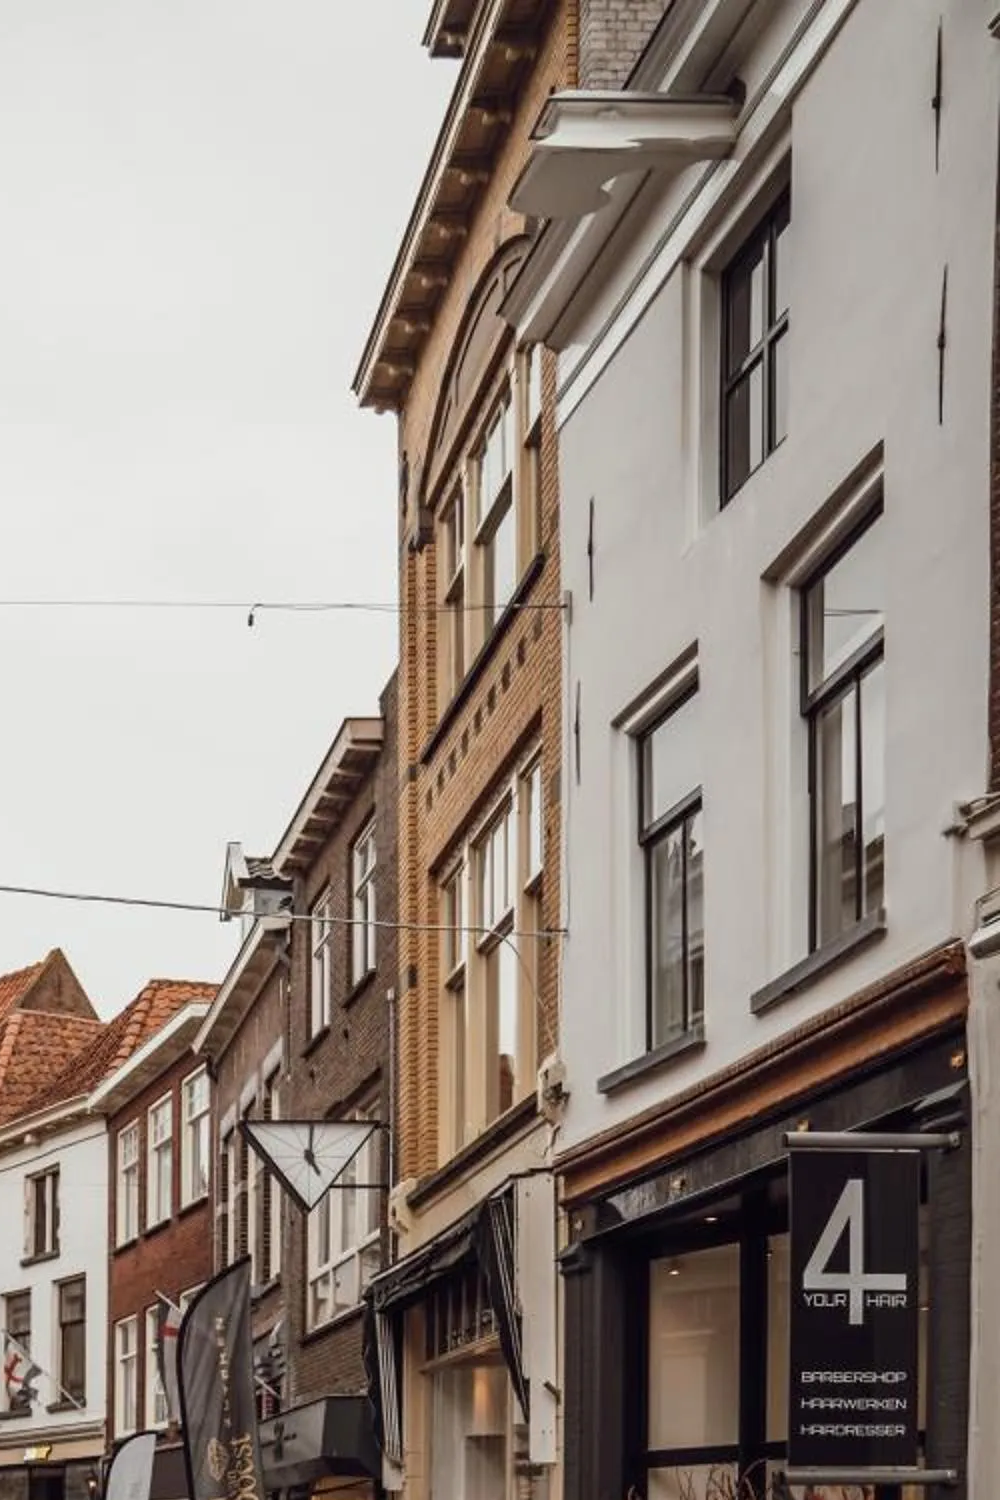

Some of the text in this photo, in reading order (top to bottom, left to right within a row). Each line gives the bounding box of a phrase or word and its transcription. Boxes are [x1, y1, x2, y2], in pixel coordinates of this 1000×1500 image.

[803, 1178, 908, 1325] 4 YOUR HAIR
[801, 1371, 908, 1384] BARBERSHOP
[801, 1398, 908, 1411] HAARWERKEN
[800, 1424, 907, 1437] HAIRDRESSER
